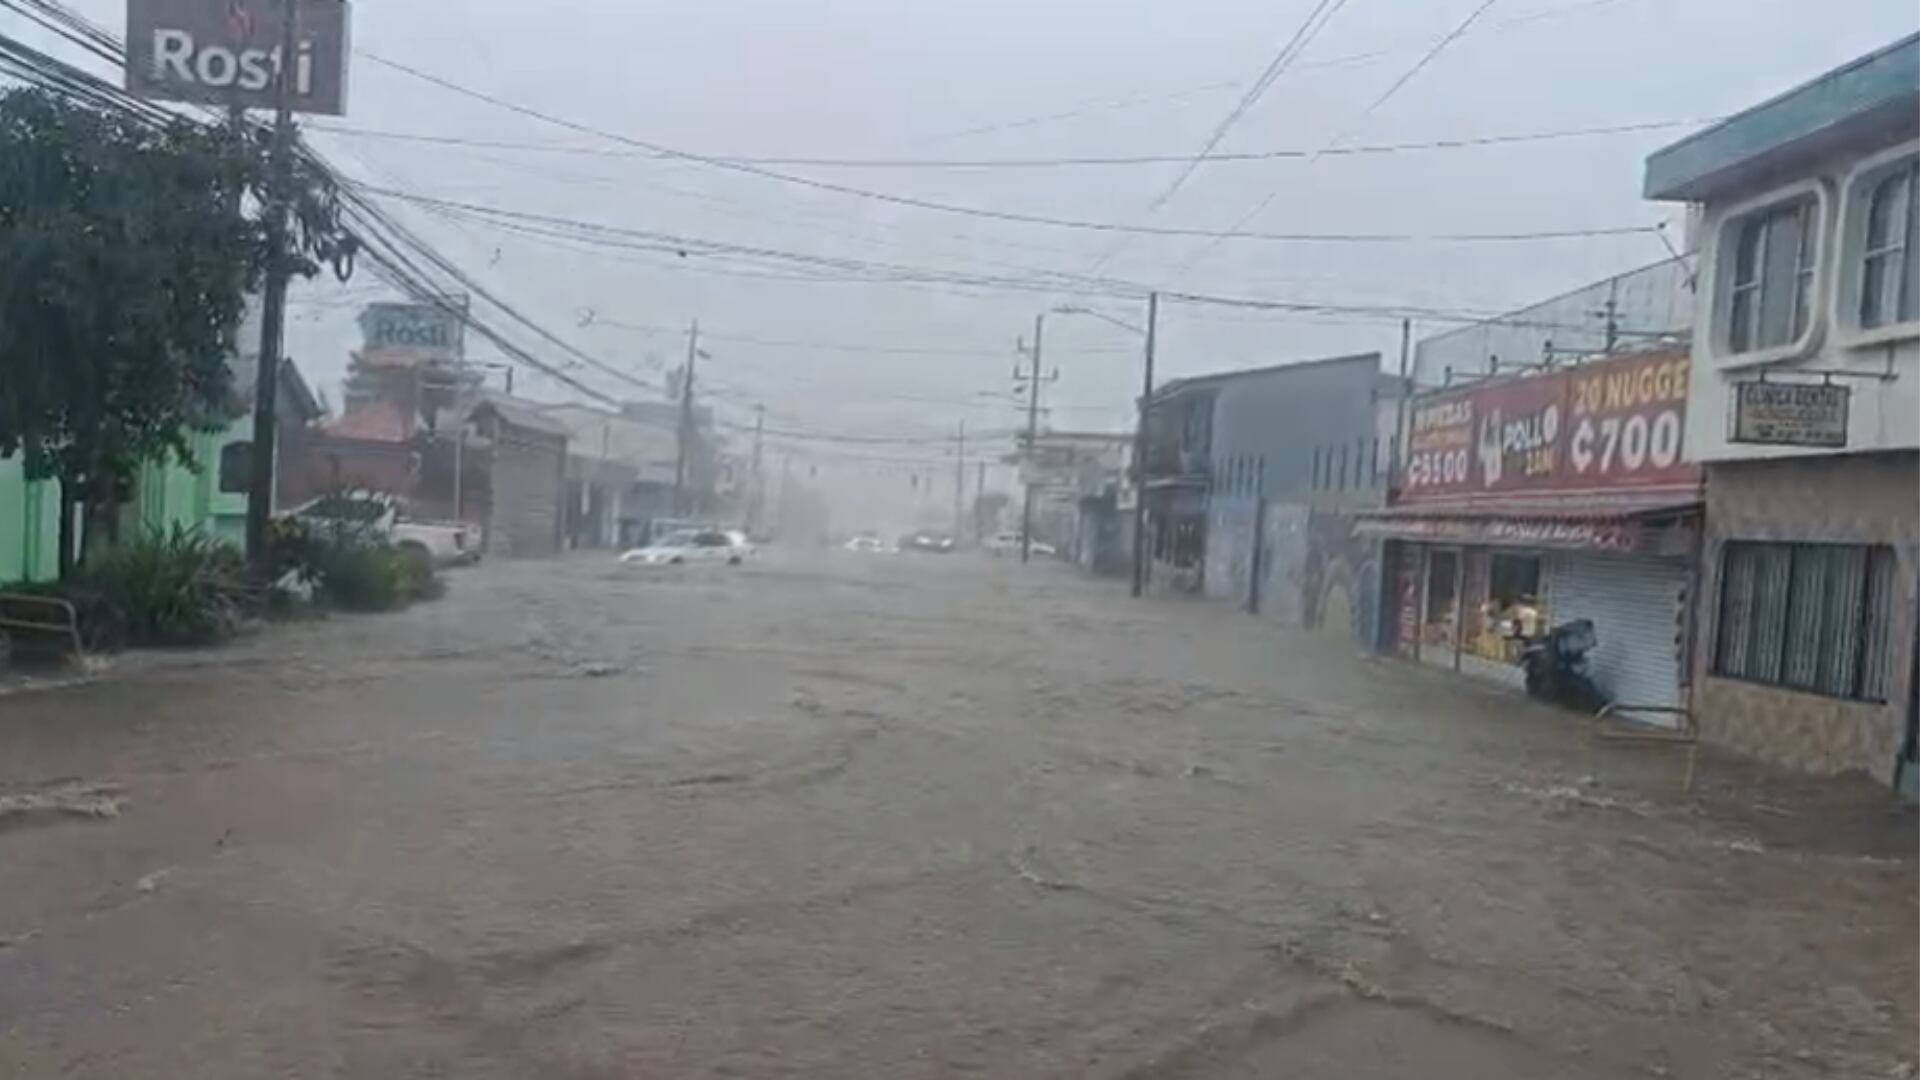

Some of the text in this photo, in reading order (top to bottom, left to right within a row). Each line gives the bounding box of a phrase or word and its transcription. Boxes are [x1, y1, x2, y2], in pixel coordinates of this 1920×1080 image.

[1574, 360, 1689, 416] 20 NUGGE
[1503, 404, 1558, 454] POLLO
